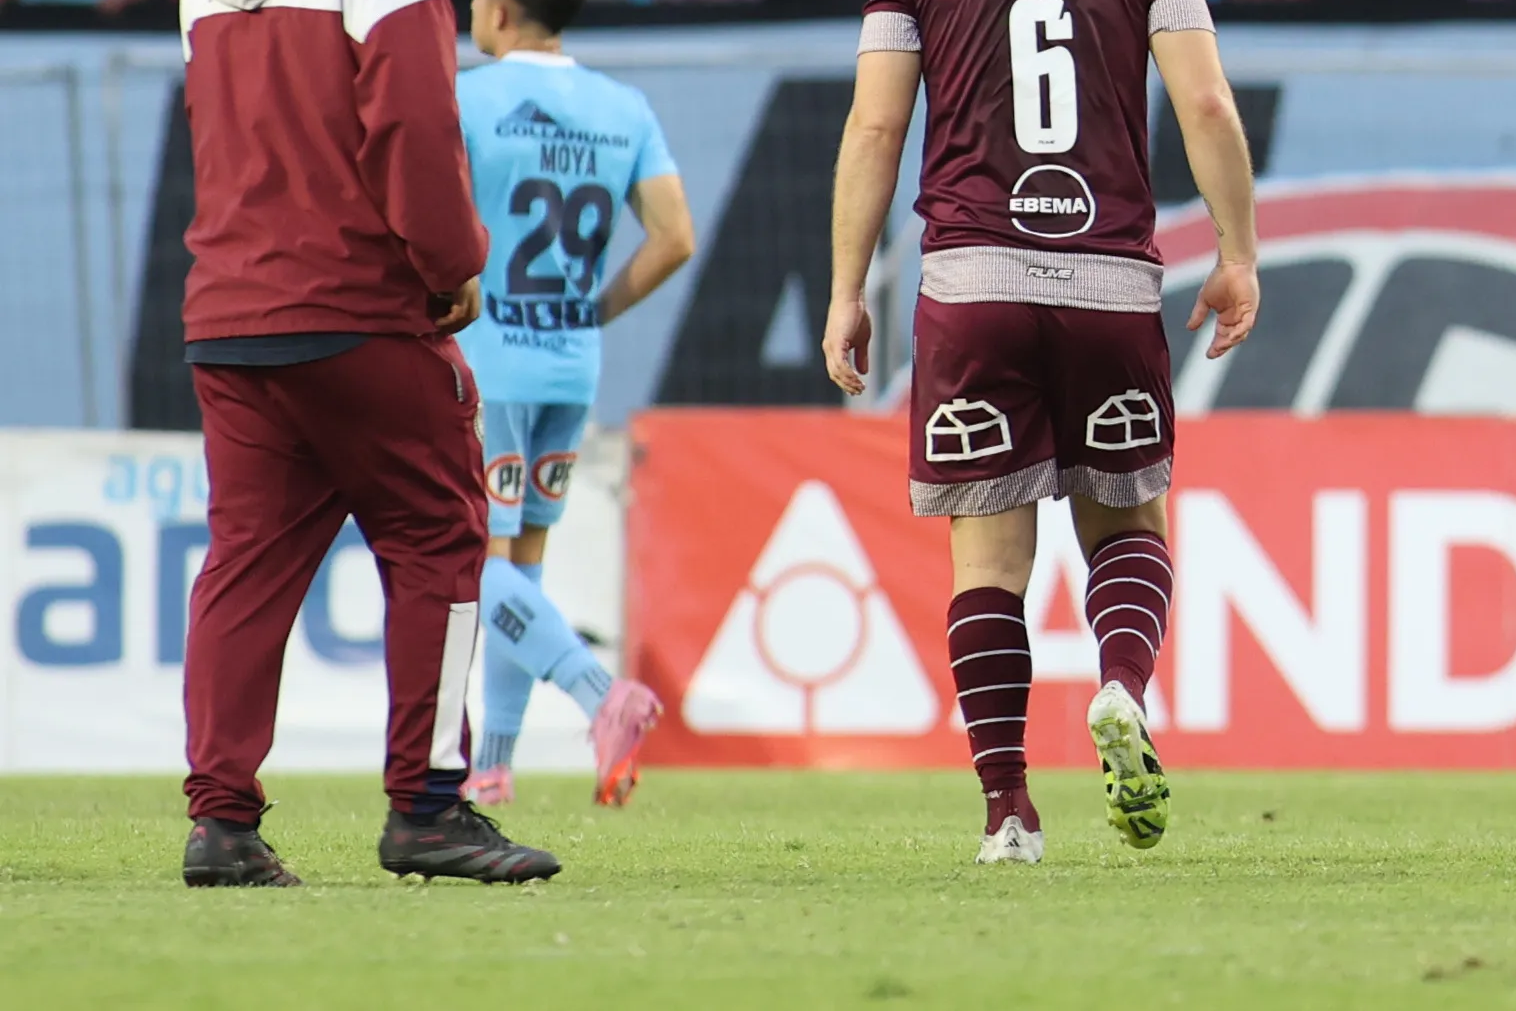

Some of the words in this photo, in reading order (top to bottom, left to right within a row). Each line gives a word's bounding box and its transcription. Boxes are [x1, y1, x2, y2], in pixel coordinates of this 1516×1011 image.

[540, 143, 598, 177] MOYA
[1009, 197, 1088, 214] EBEMA
[506, 178, 613, 298] 29
[1026, 266, 1074, 280] FIUME
